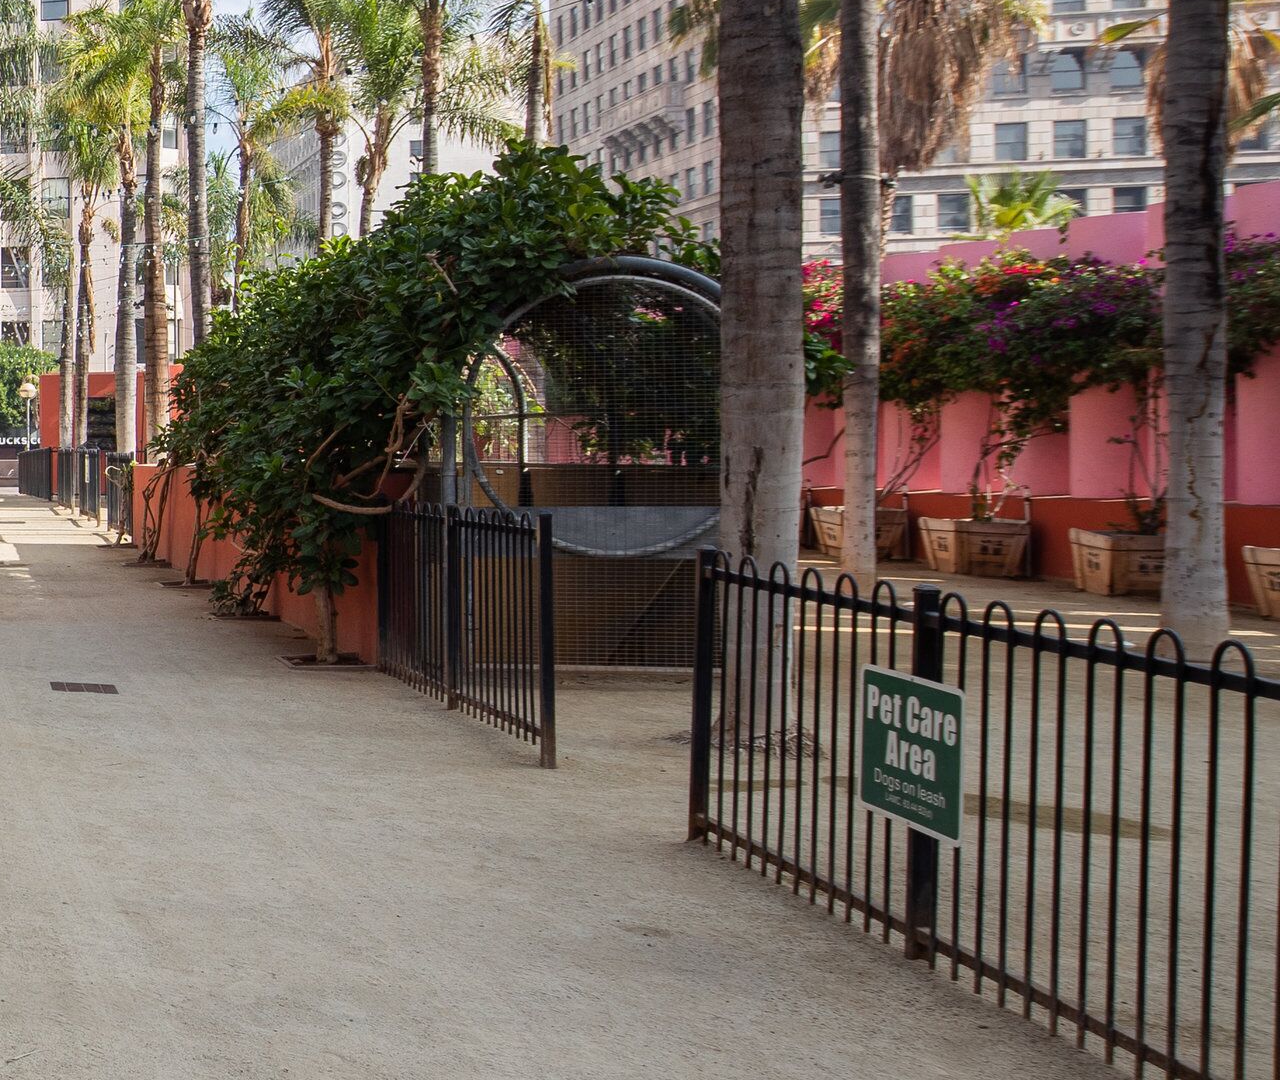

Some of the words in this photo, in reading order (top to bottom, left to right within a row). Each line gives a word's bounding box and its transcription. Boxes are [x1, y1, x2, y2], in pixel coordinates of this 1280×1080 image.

[867, 684, 902, 728] Pet
[906, 696, 957, 746] Care
[884, 730, 936, 781] Area
[874, 767, 901, 792] Dogs
[901, 781, 916, 796] on
[916, 782, 946, 809] leash
